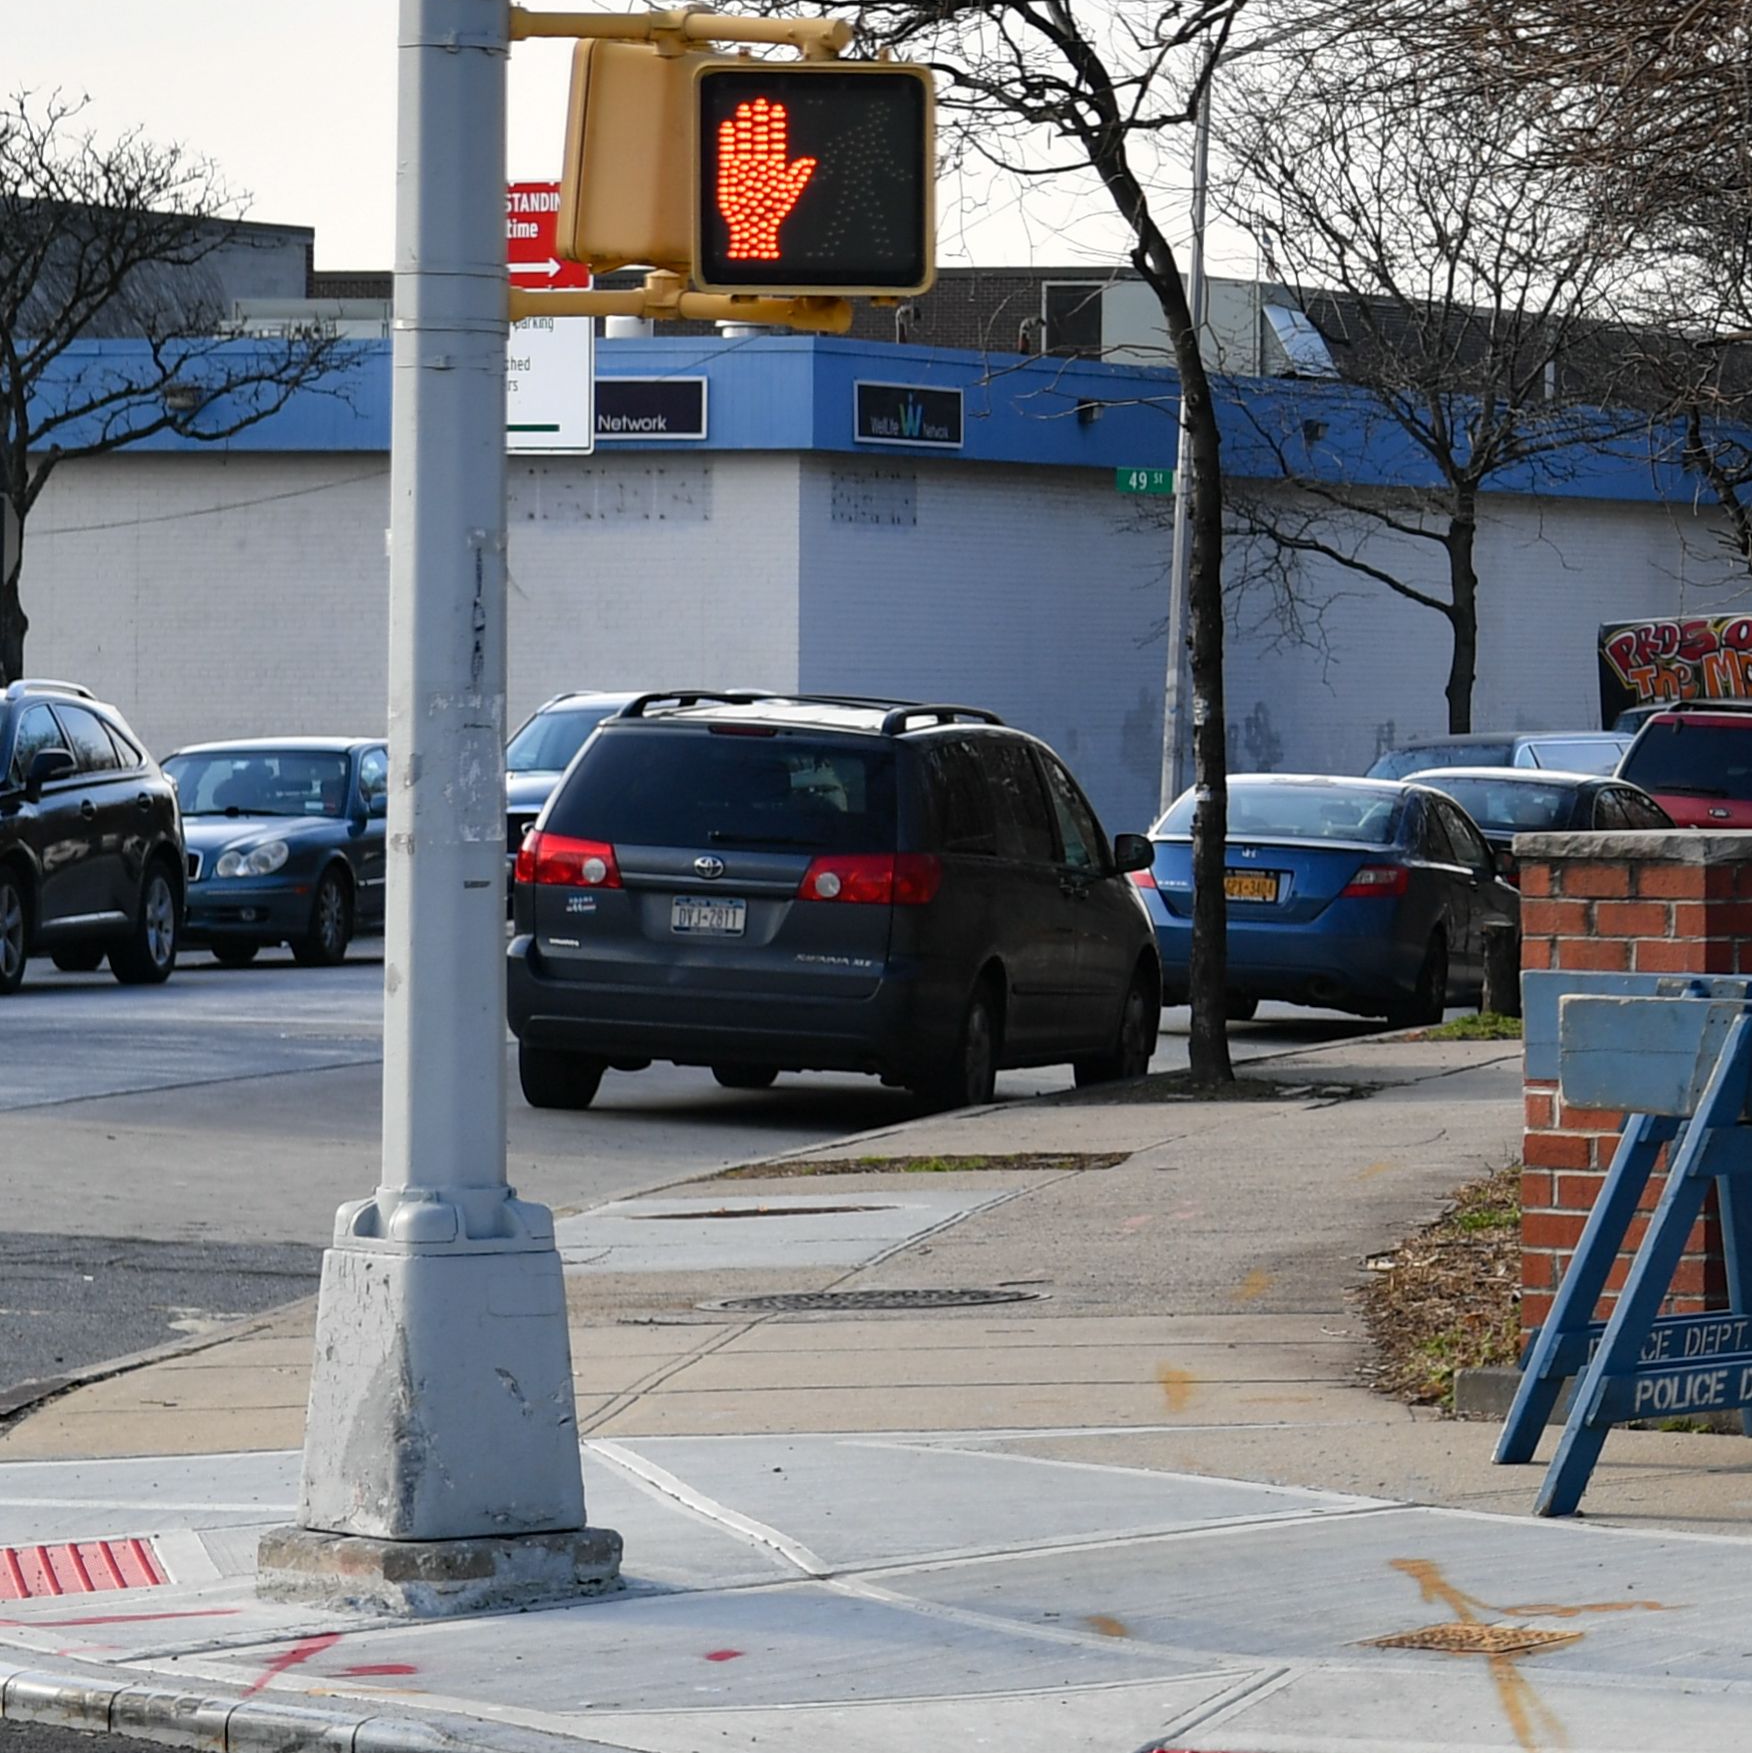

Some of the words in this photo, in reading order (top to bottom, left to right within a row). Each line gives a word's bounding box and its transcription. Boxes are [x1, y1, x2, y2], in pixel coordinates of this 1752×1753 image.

[504, 192, 560, 213] STANDIN
[597, 413, 667, 431] Network
[1129, 471, 1148, 490] 49
[1684, 1321, 1749, 1358] DEPT.
[1634, 1368, 1729, 1413] POLICE
